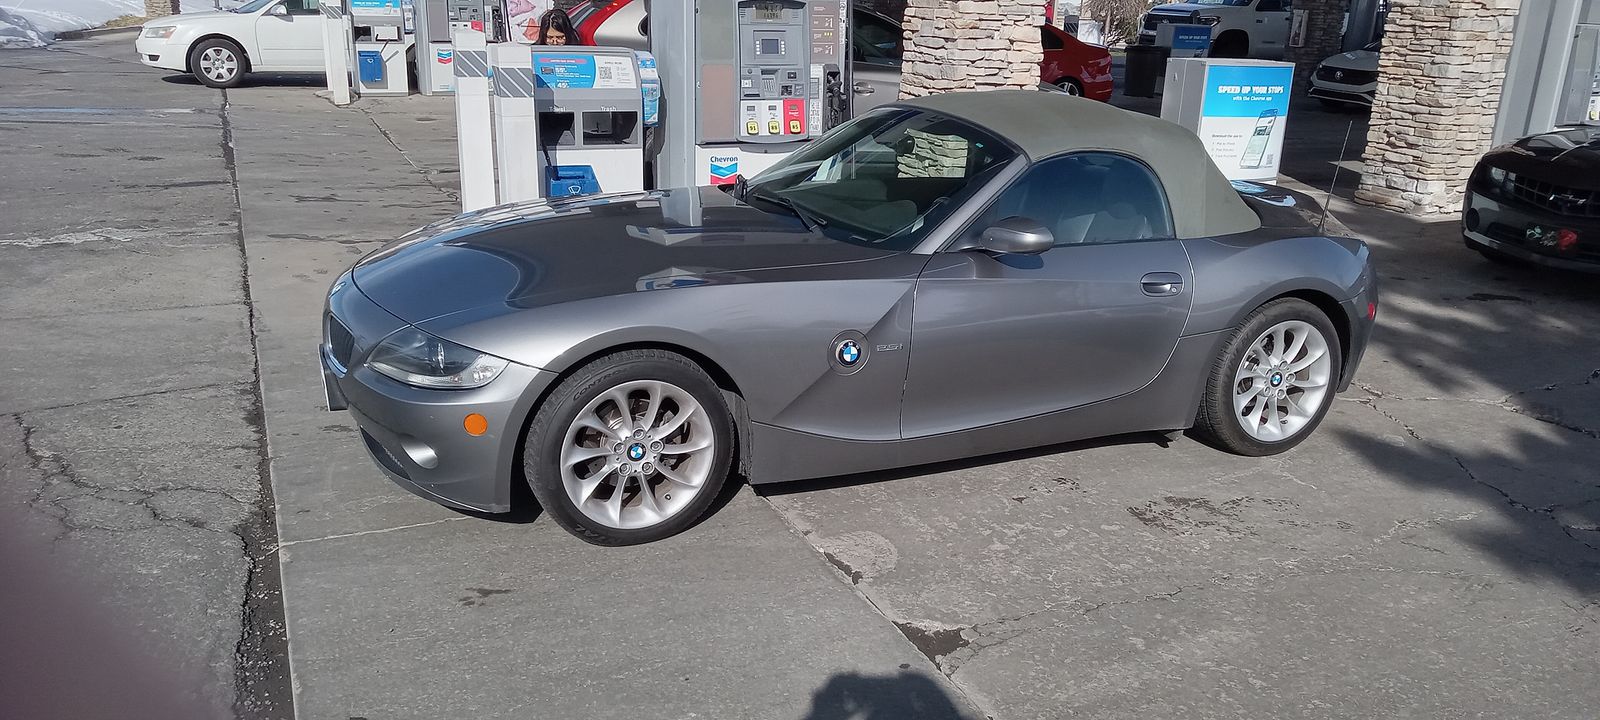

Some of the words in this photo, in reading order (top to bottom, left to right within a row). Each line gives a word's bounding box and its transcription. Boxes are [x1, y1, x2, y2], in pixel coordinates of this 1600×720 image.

[1217, 85, 1241, 94] SPEED
[1241, 85, 1251, 94] UP
[1252, 85, 1268, 94] YOUR
[1267, 86, 1284, 94] STOPS
[710, 155, 738, 163] Chevron
